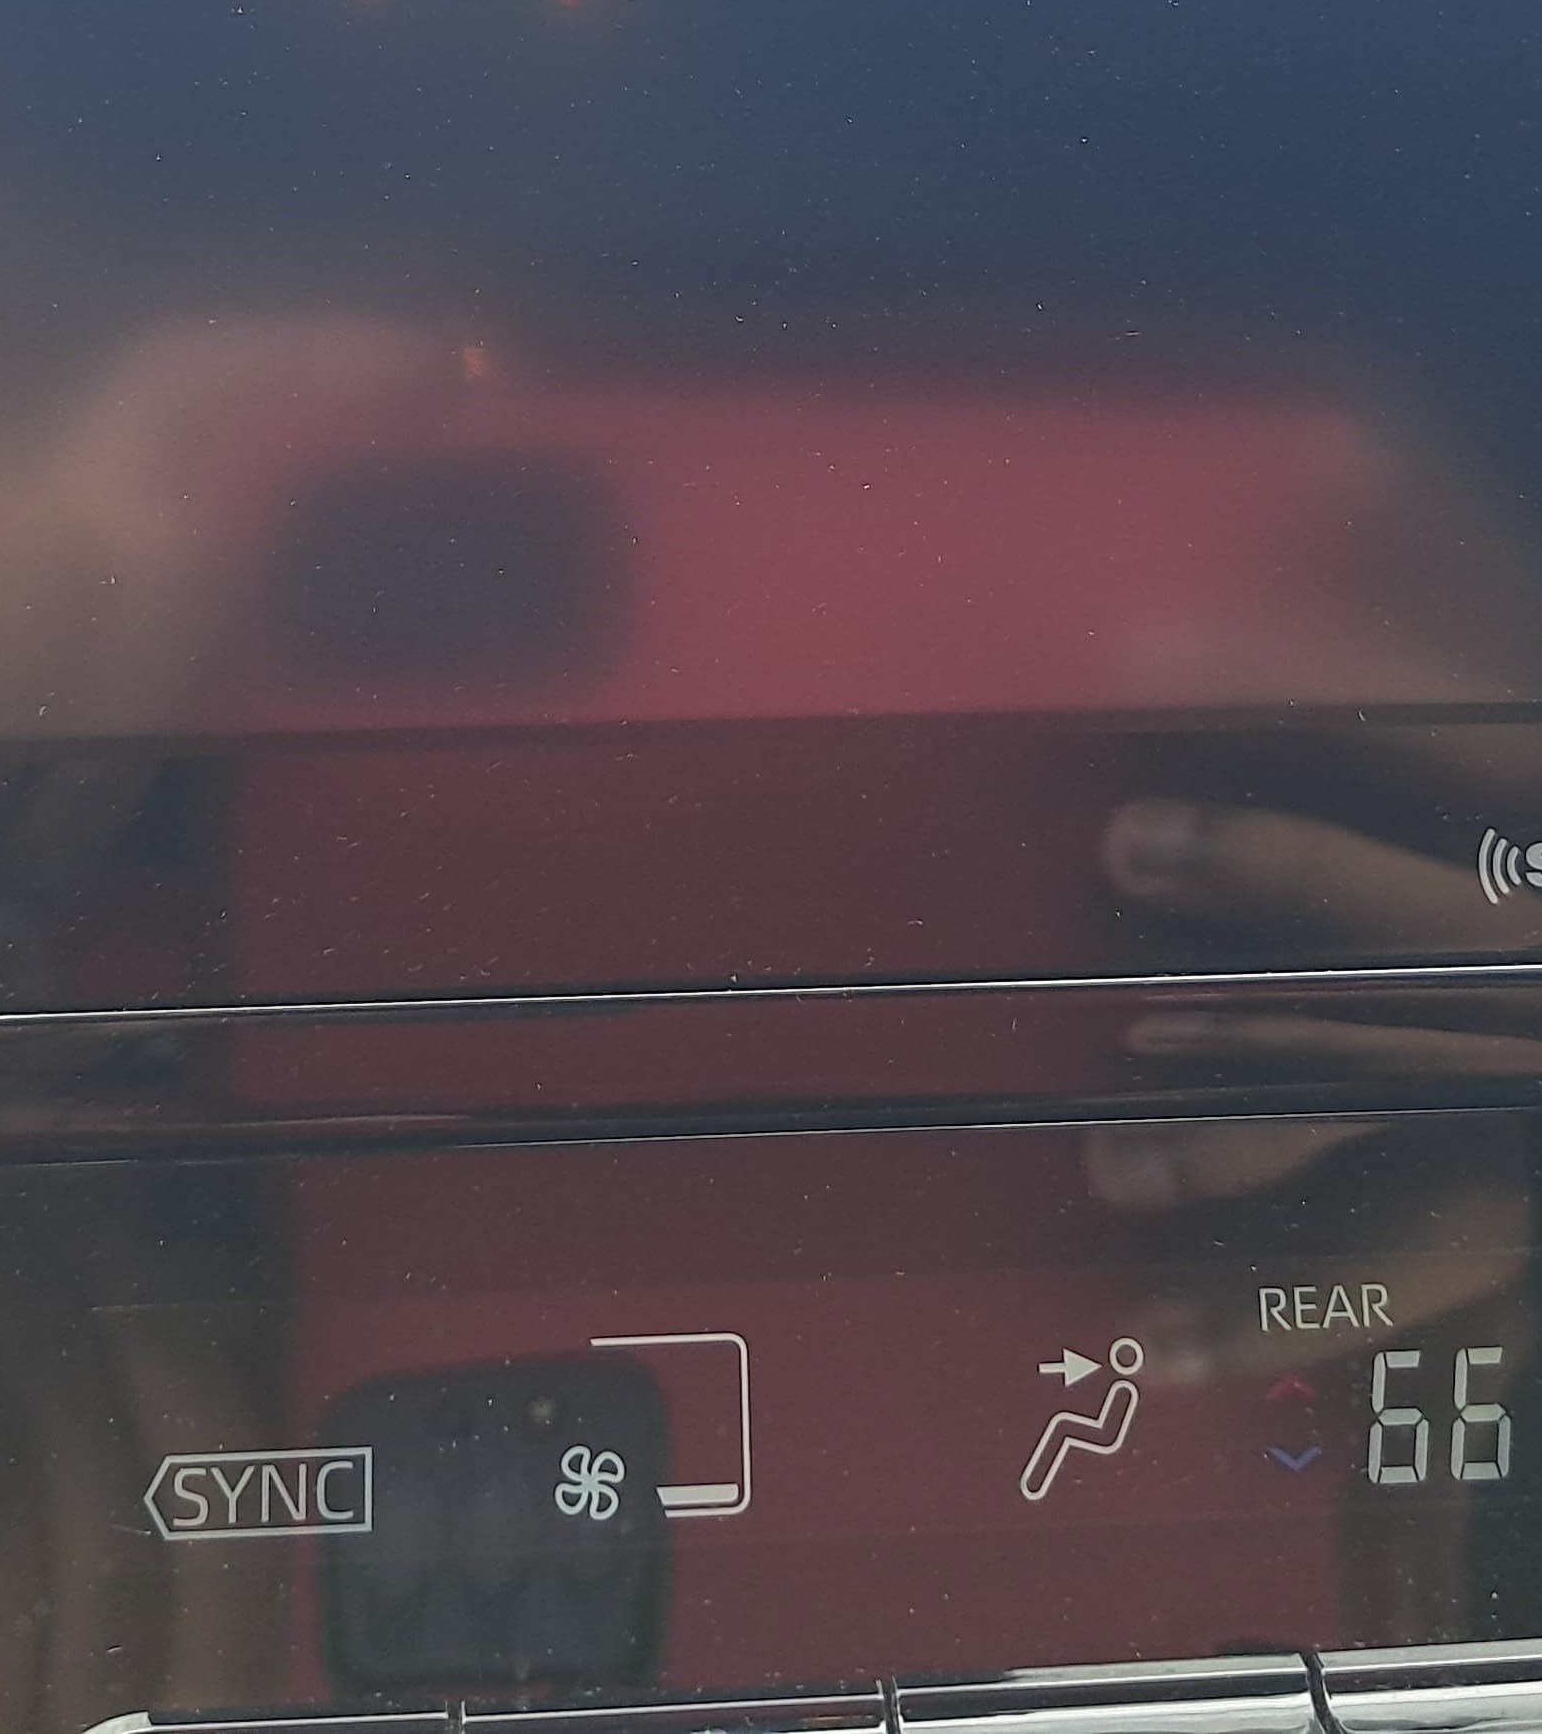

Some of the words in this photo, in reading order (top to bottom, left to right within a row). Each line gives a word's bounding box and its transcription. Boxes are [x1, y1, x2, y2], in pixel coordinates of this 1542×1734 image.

[1260, 1285, 1392, 1331] REAR
[1369, 1348, 1510, 1484] 66
[173, 1460, 353, 1528] SYNC
